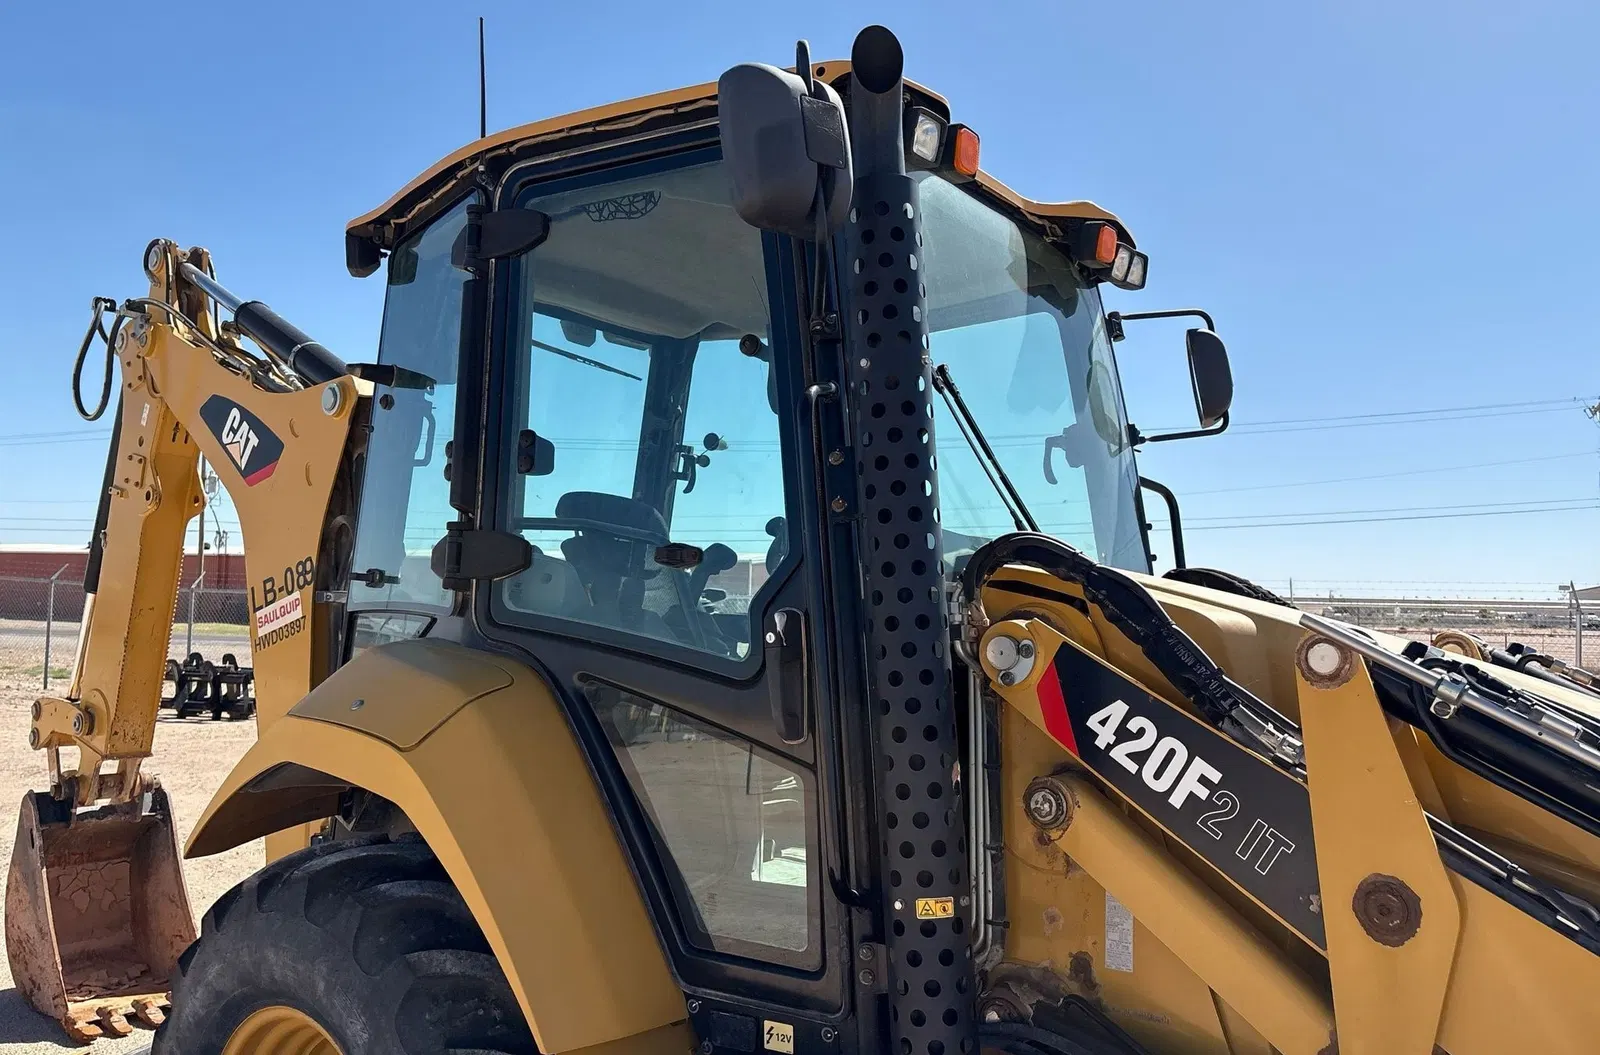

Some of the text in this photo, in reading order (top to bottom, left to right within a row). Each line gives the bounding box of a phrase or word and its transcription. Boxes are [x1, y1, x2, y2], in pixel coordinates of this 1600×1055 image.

[222, 407, 259, 471] CAT
[251, 556, 315, 613] LB-089
[254, 615, 307, 653] HWD03897
[257, 598, 301, 629] SAULQUIP
[1235, 818, 1295, 876] IT
[775, 1033, 792, 1044] 12V
